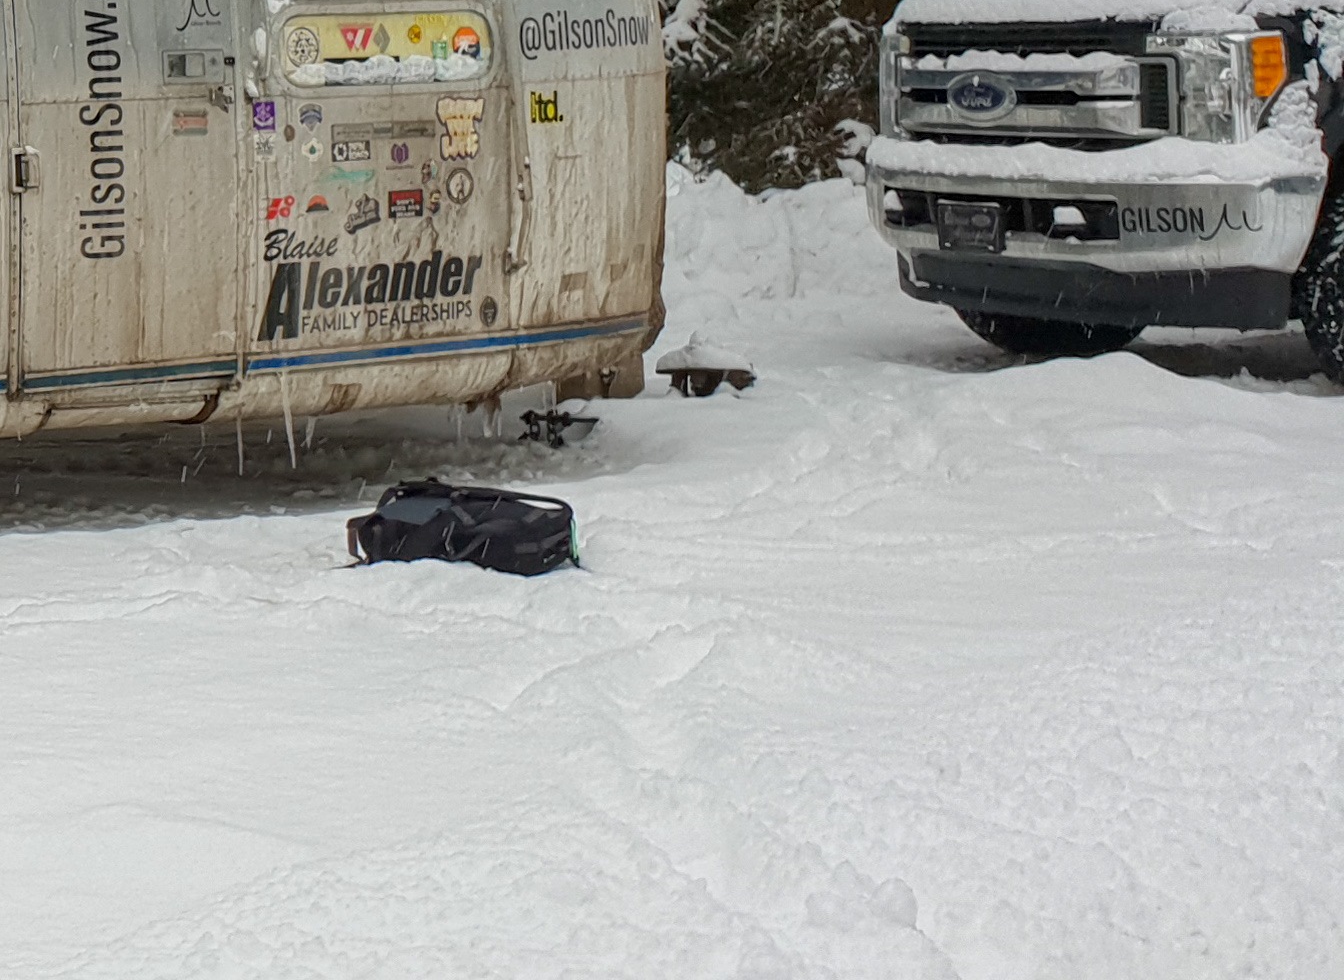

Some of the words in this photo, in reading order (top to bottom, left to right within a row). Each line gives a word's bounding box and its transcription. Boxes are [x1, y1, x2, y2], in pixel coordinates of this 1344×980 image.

[519, 9, 650, 60] @GilsonSnow
[1122, 206, 1205, 234] GILSON
[263, 228, 339, 262] Blaise
[257, 249, 483, 341] Alexander
[302, 311, 362, 334] FAMILY
[367, 300, 473, 328] DEALERSHIPS
